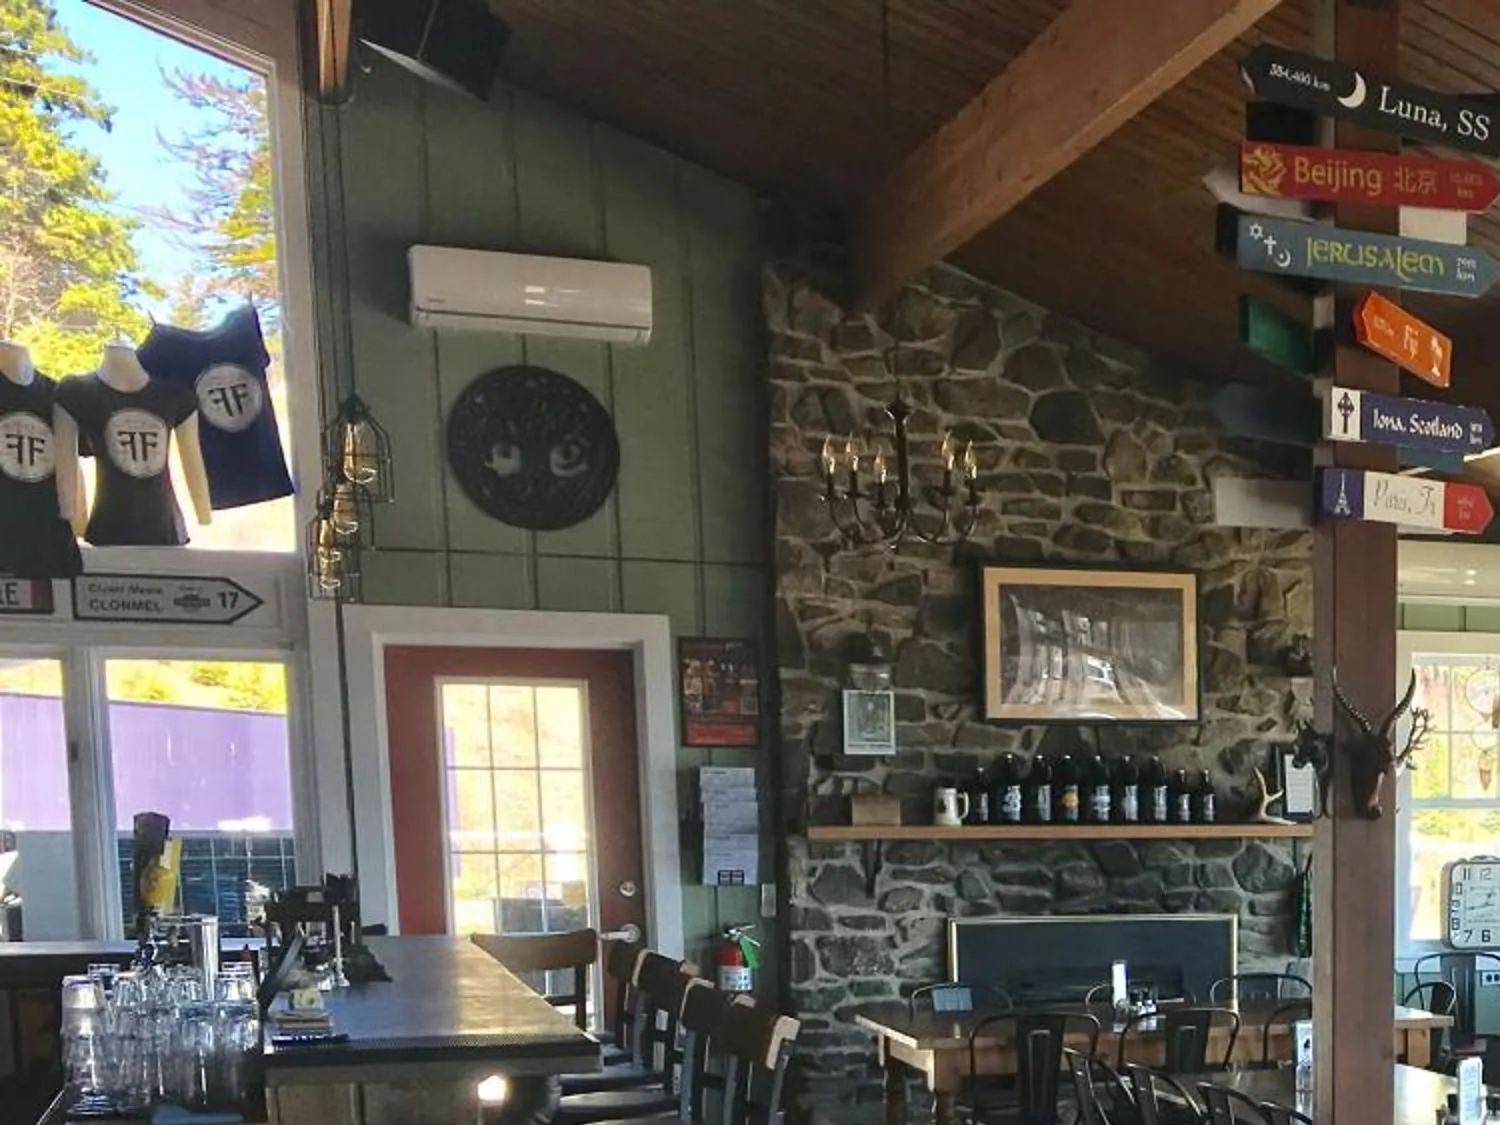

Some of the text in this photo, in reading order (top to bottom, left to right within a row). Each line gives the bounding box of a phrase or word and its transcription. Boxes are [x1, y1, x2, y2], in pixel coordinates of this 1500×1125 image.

[1379, 85, 1491, 141] Luna, SS
[1294, 155, 1383, 195] Beijing
[1393, 166, 1438, 195] 北京
[1409, 412, 1464, 440] Scotland
[217, 591, 240, 609] 17
[1463, 929, 1473, 943] 7
[1481, 929, 1491, 943] 6
